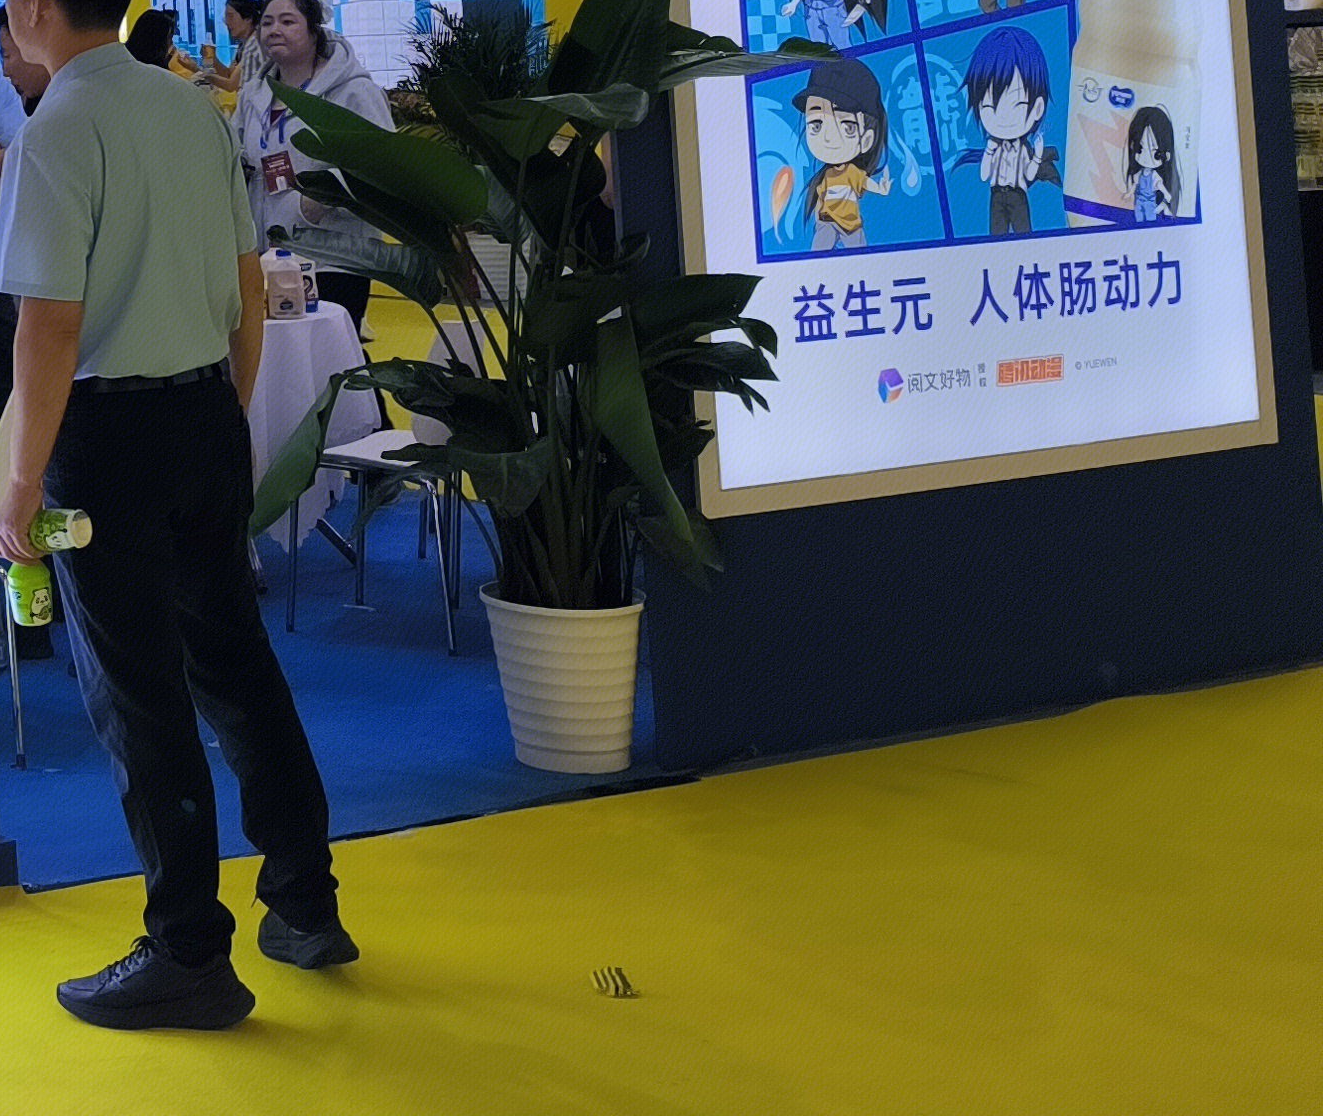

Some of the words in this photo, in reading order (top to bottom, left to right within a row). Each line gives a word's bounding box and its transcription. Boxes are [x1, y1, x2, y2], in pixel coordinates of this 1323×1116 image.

[793, 276, 933, 343] 益生元
[970, 250, 1182, 325] 人体肠动力
[1084, 357, 1118, 370] YUEWEN
[907, 369, 971, 393] 阅文好物
